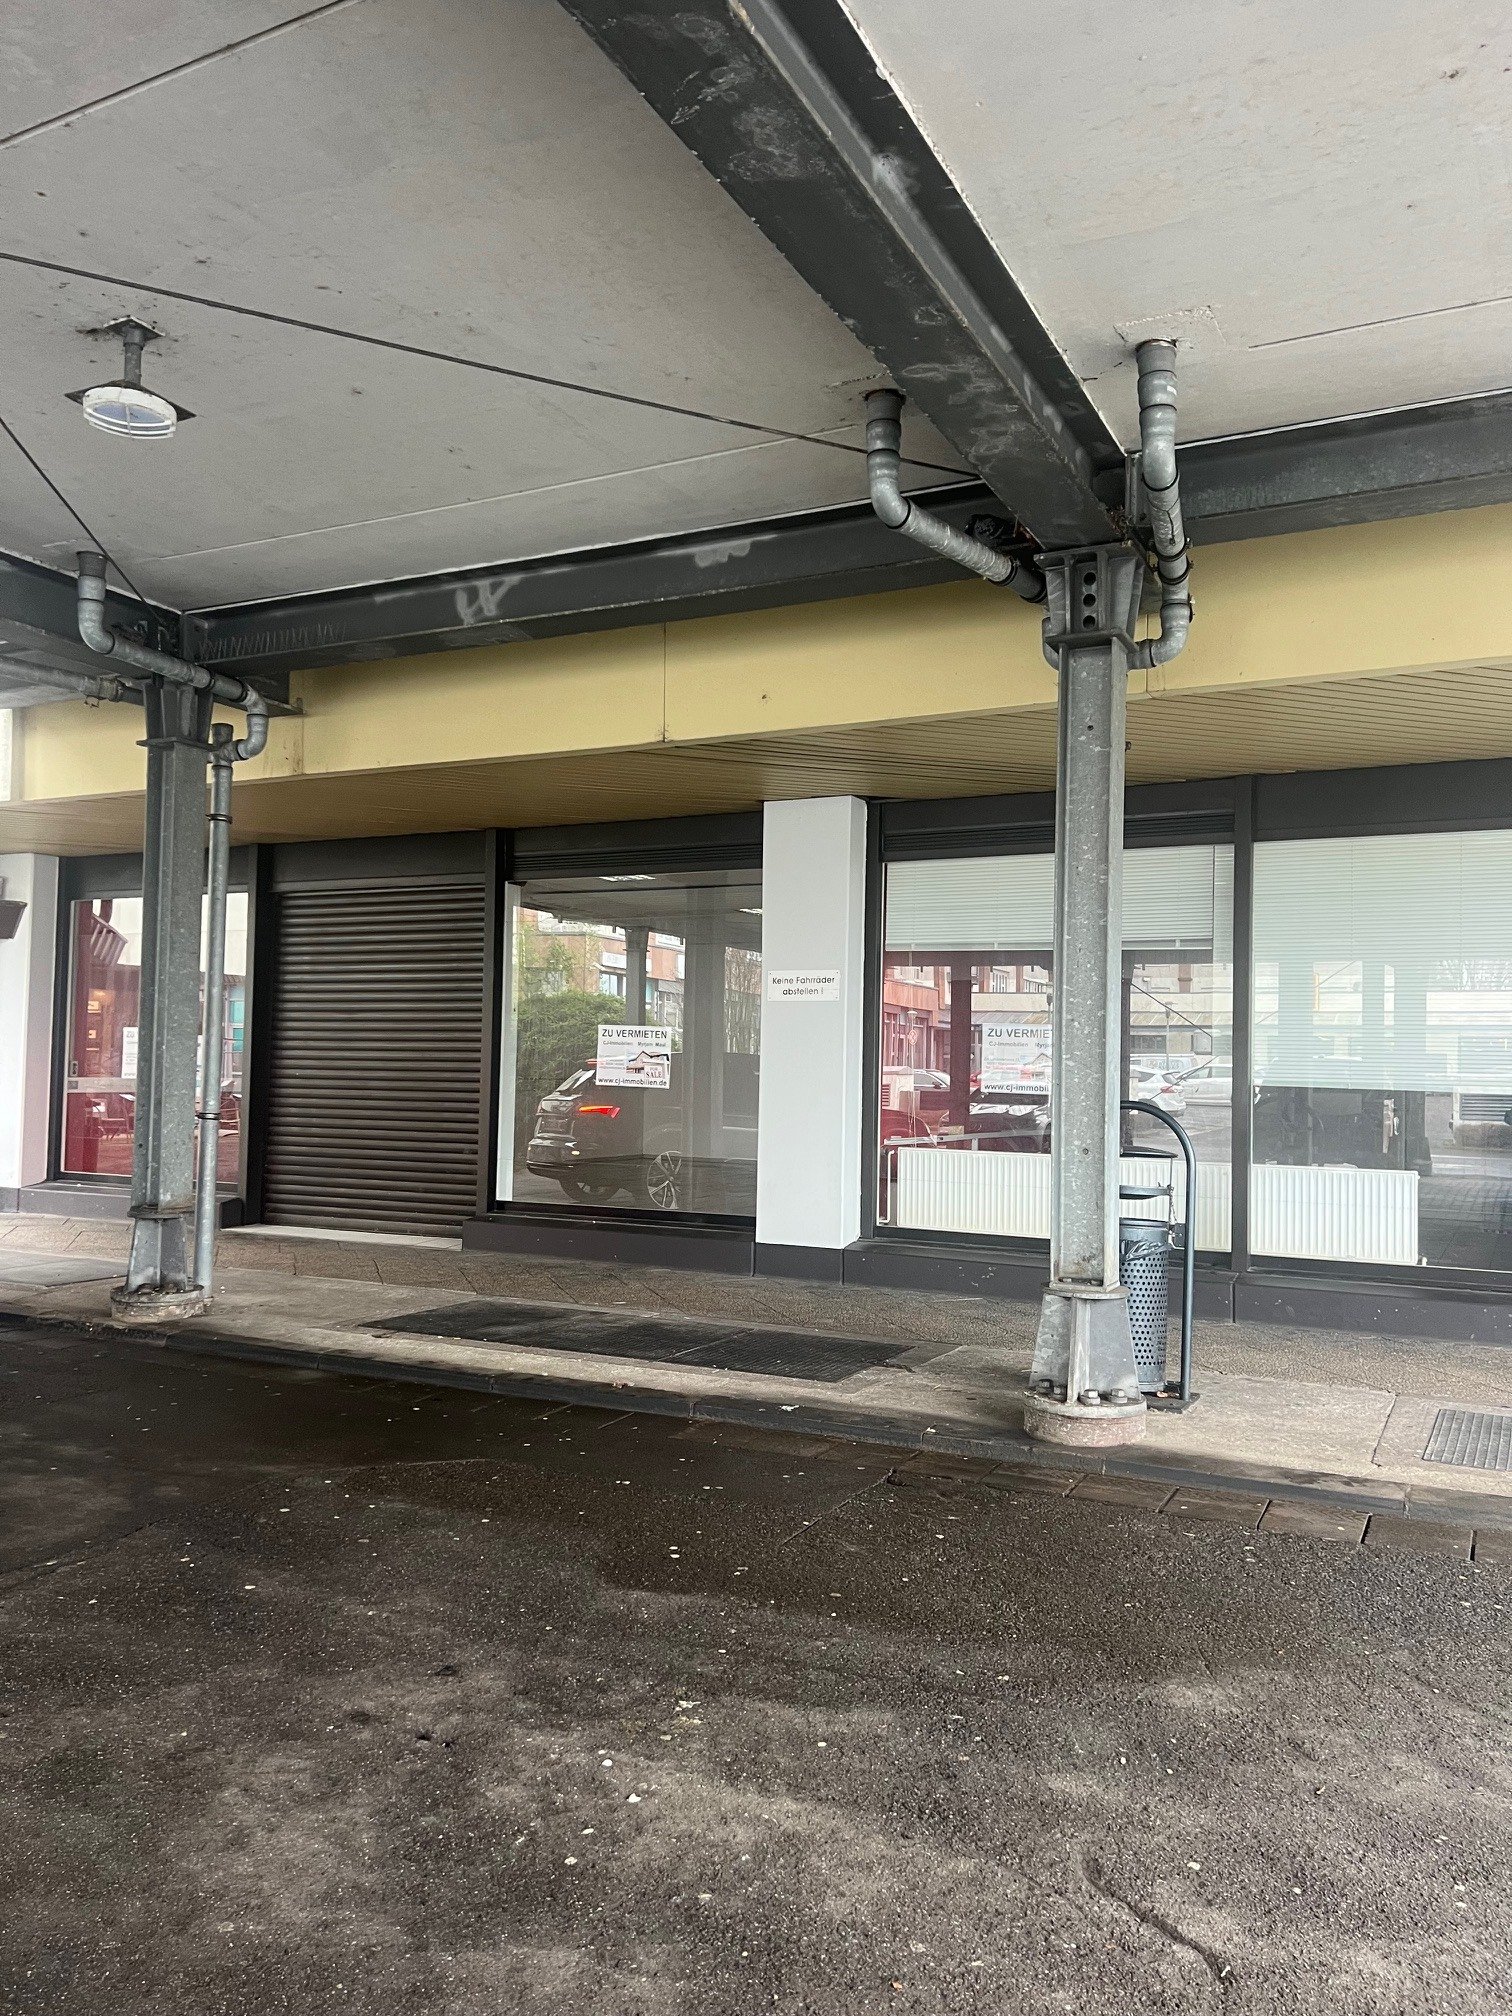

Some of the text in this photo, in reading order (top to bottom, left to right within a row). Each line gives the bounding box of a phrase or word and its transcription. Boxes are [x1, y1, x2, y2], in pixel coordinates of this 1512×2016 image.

[796, 976, 835, 984] Fahrräder
[782, 987, 819, 995] abstellen
[602, 1028, 668, 1039] ZU VERMIETEN
[987, 1028, 1052, 1039] ZU VERMIE
[598, 1078, 668, 1087] www.cj-immobilien.de
[984, 1084, 1050, 1092] www.cj-immobil
